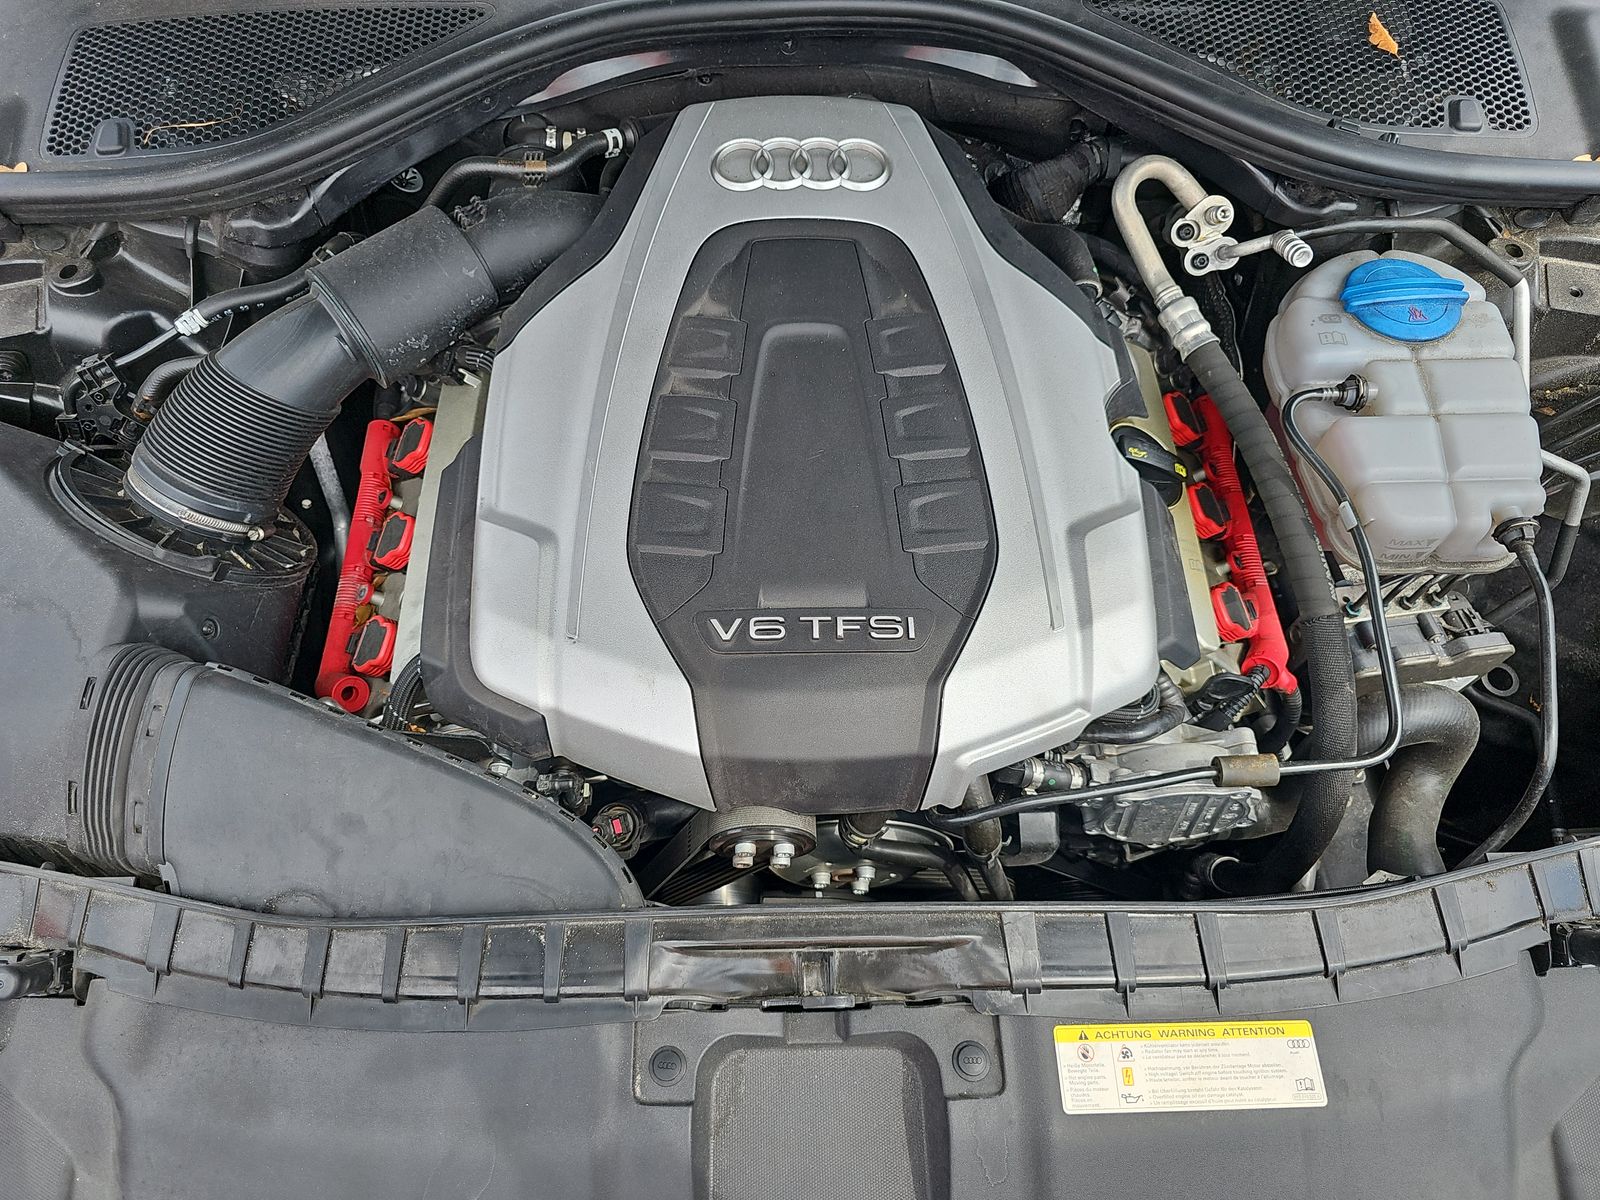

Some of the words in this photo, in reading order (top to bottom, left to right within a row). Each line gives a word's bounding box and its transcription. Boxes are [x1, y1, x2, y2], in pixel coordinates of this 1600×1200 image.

[709, 616, 786, 641] V6
[799, 615, 916, 640] TFSI
[1095, 1030, 1152, 1040] ACHTUNG
[1158, 1028, 1216, 1038] WARNING
[1222, 1026, 1285, 1036] ATTENTION
